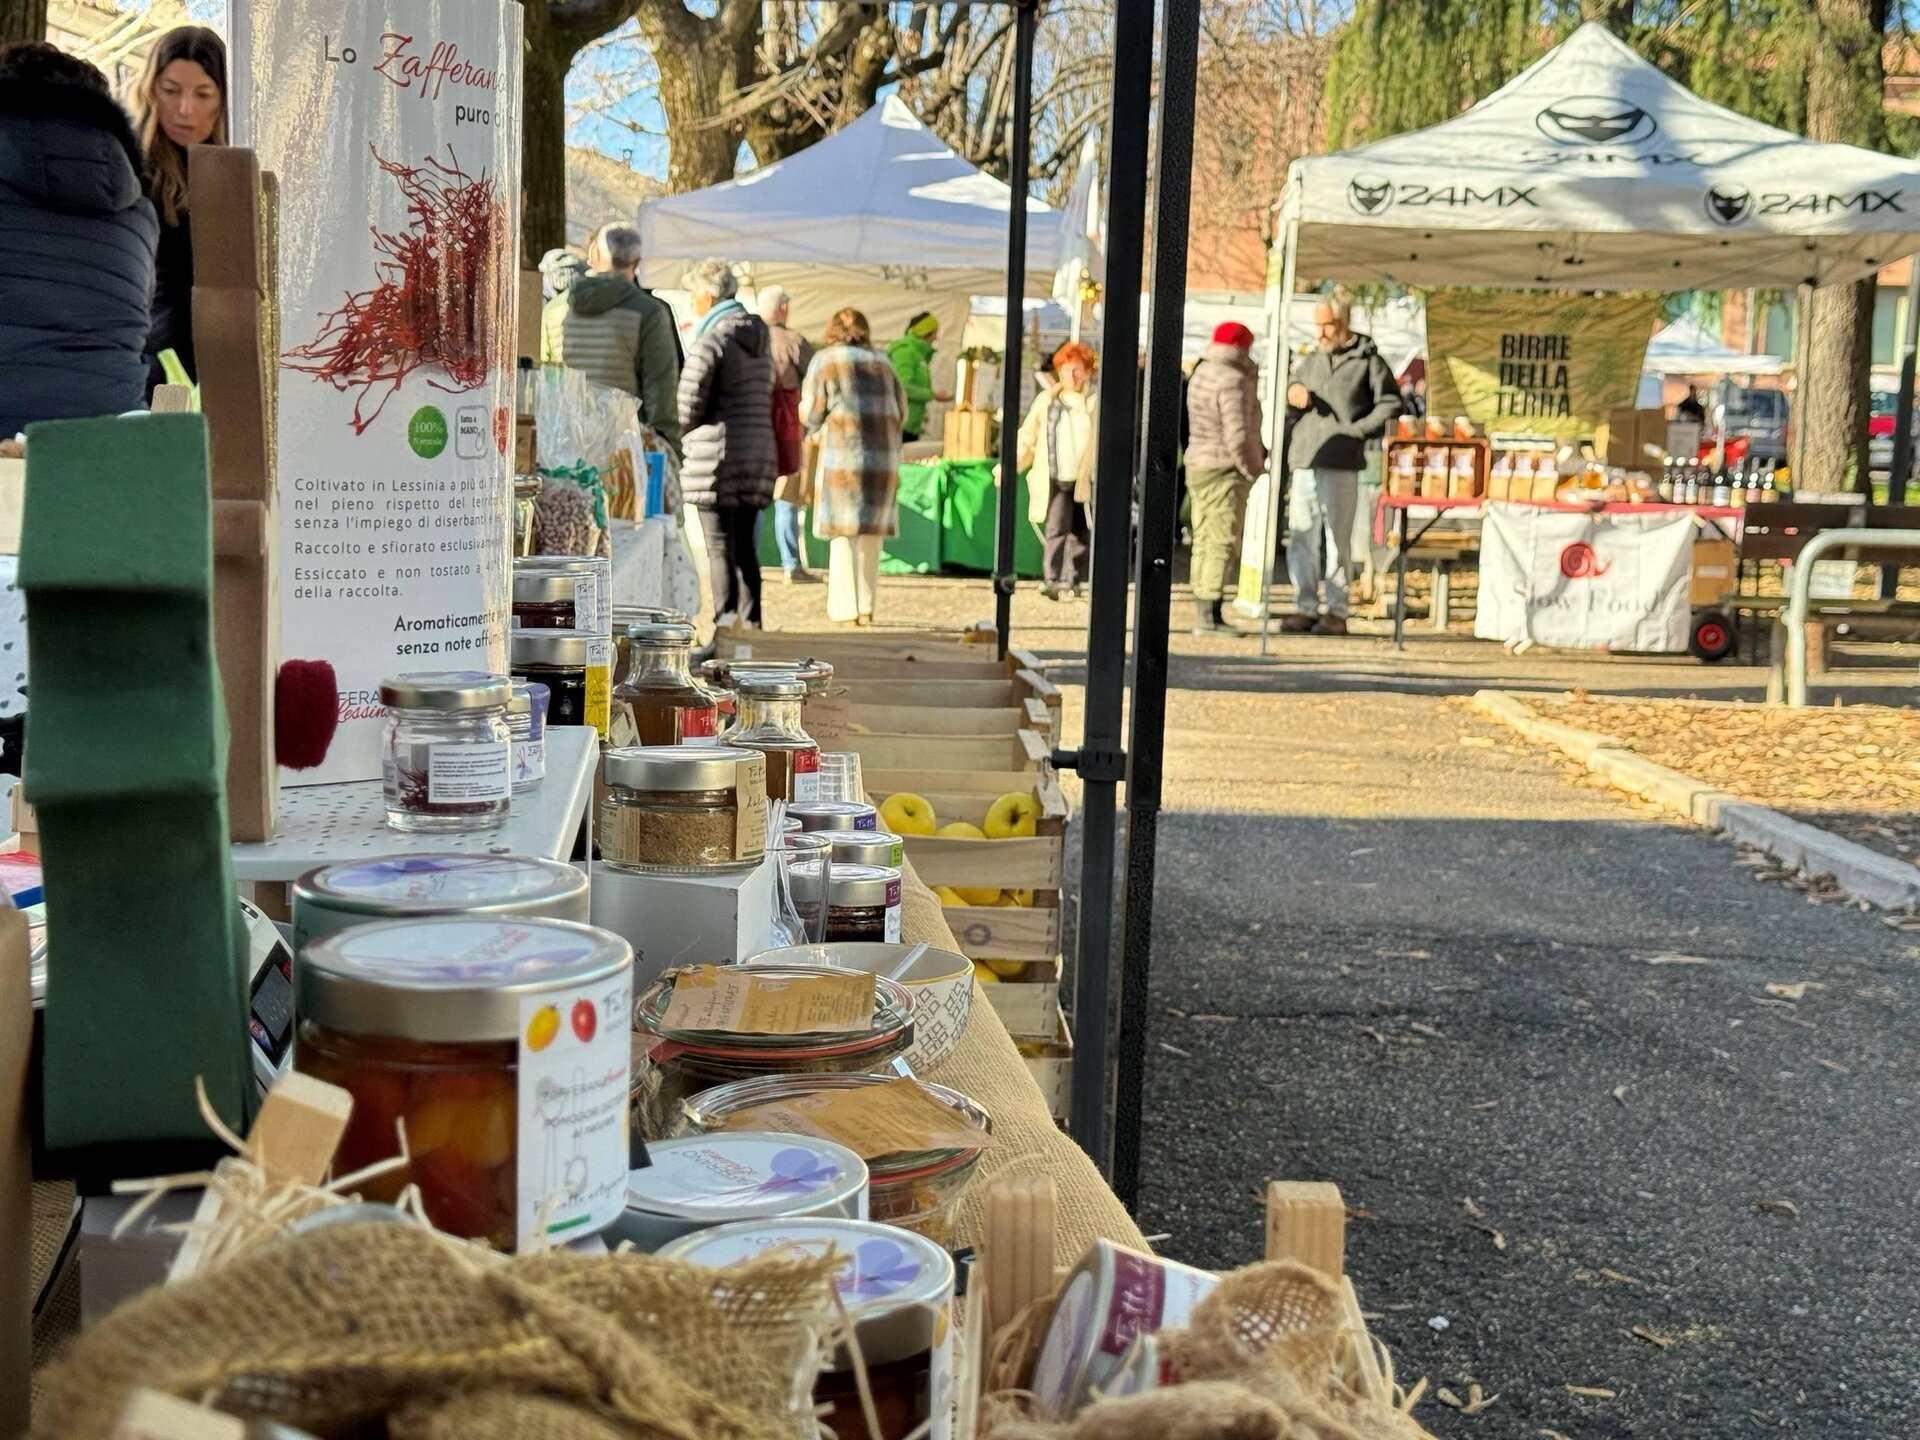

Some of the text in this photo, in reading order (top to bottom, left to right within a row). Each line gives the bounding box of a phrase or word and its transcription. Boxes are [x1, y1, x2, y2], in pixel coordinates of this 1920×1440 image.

[325, 33, 505, 100] Lo Zafferano
[456, 105, 490, 126] puro
[1400, 184, 1538, 207] 24MX
[1758, 190, 1905, 215] 24MX
[1502, 334, 1572, 360] BIRRE
[1500, 364, 1567, 389] DELLA
[1496, 391, 1570, 418] TERRA
[295, 479, 365, 492] Coltivato
[372, 480, 385, 491] in
[392, 479, 445, 491] Lessinia
[450, 482, 456, 491] a
[460, 478, 476, 494] più
[295, 497, 318, 511] nel
[331, 498, 374, 513] pieno
[386, 497, 440, 513] rispetto
[449, 496, 465, 509] del
[295, 518, 339, 529] senza
[346, 517, 412, 531] l'impiego
[418, 516, 430, 529] di
[435, 514, 487, 528] diserbanti
[295, 542, 361, 554] Raccolto
[368, 545, 376, 554] e
[382, 540, 435, 553] sfiorato
[295, 567, 367, 580] Essiccato
[378, 570, 386, 579] e
[396, 567, 421, 578] non
[430, 565, 470, 577] tostato
[295, 584, 403, 598] della raccolta.
[394, 609, 495, 632] Aromaticamente
[396, 639, 440, 655] senza
[445, 635, 472, 652] note
